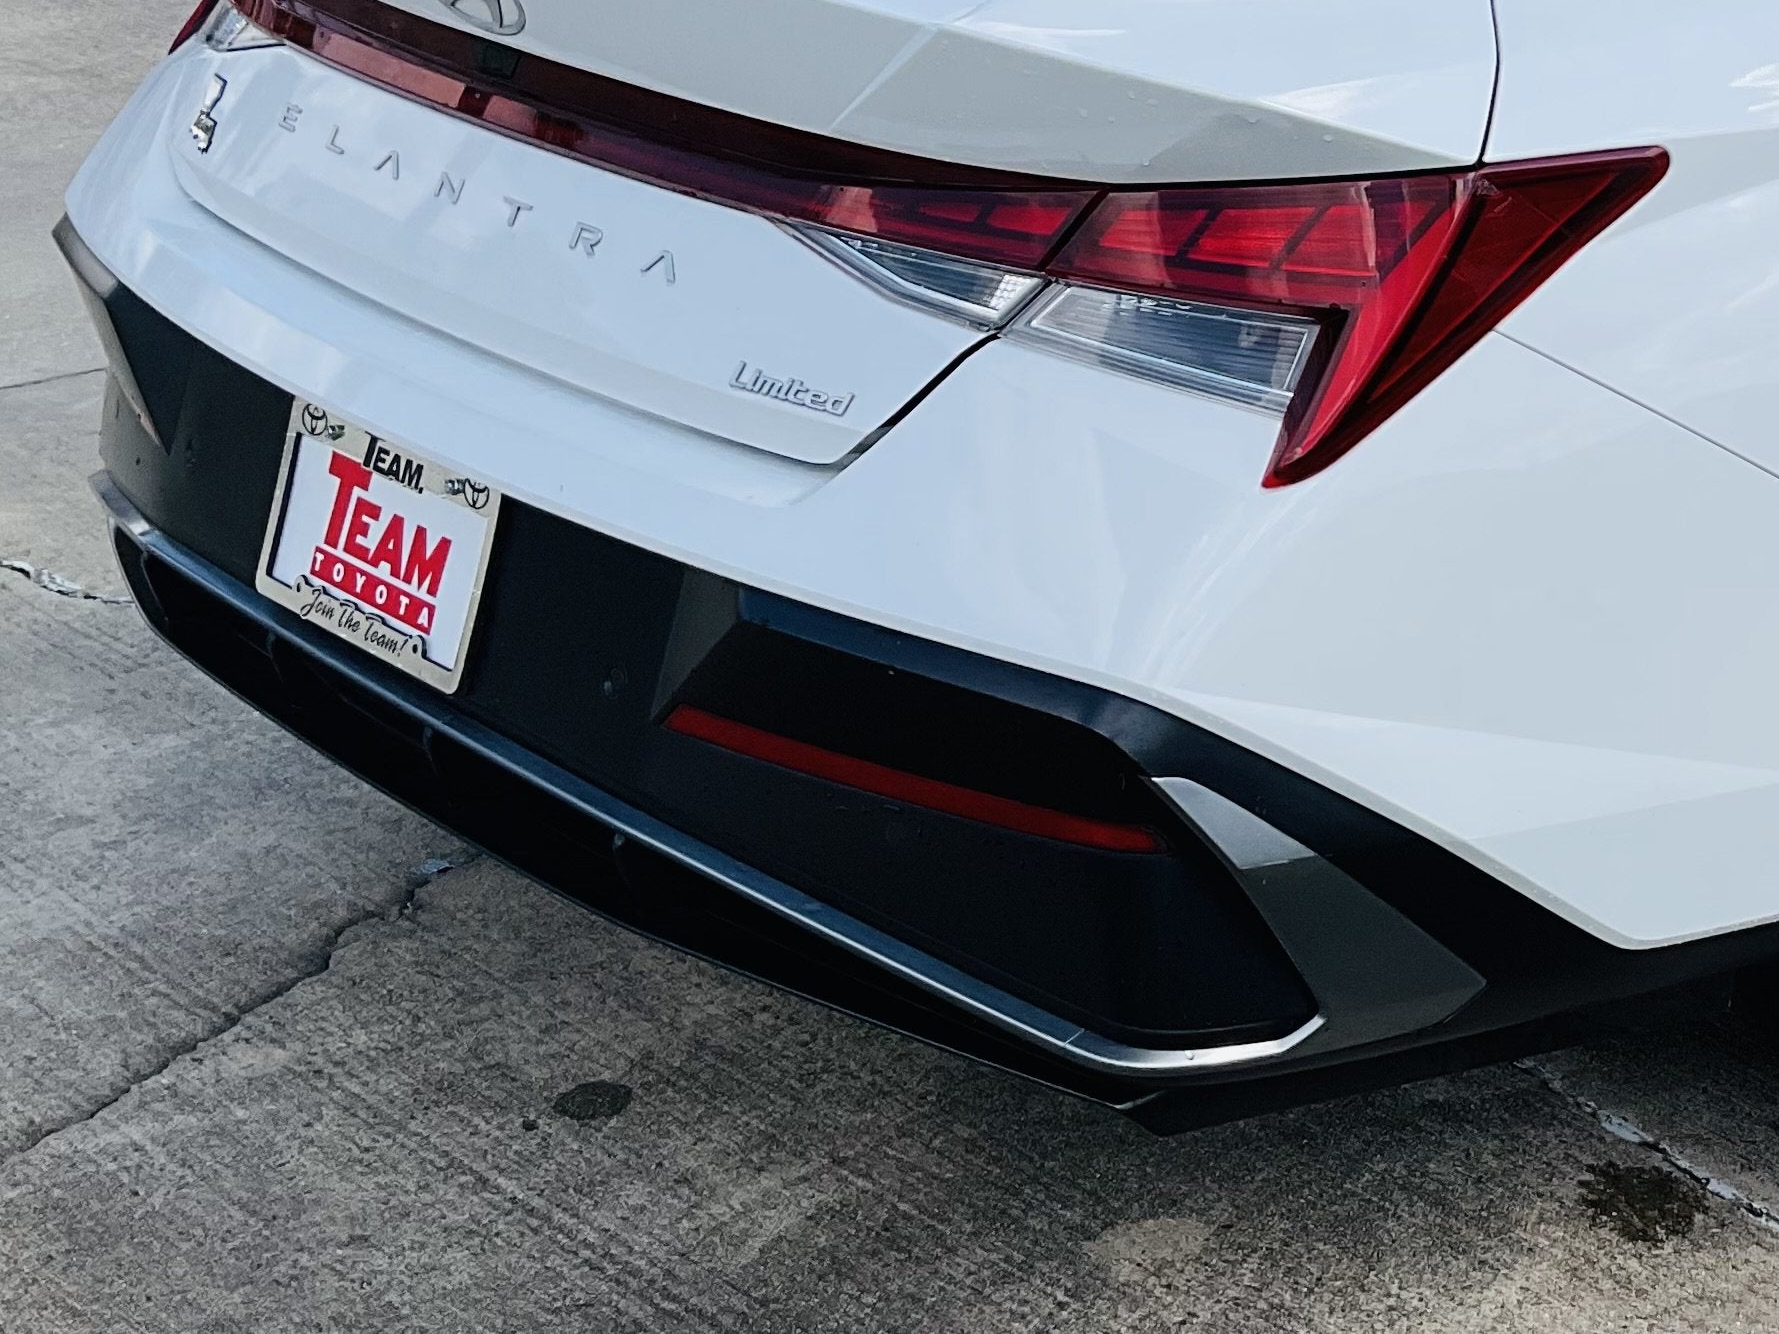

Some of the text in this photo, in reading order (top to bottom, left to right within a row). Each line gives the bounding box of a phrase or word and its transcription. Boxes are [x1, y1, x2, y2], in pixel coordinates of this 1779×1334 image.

[278, 103, 677, 285] ELANTRA
[729, 360, 855, 417] Limited
[323, 450, 453, 598] TEAM
[300, 587, 409, 657] Join The Team!
[314, 551, 430, 629] TOYOTA
